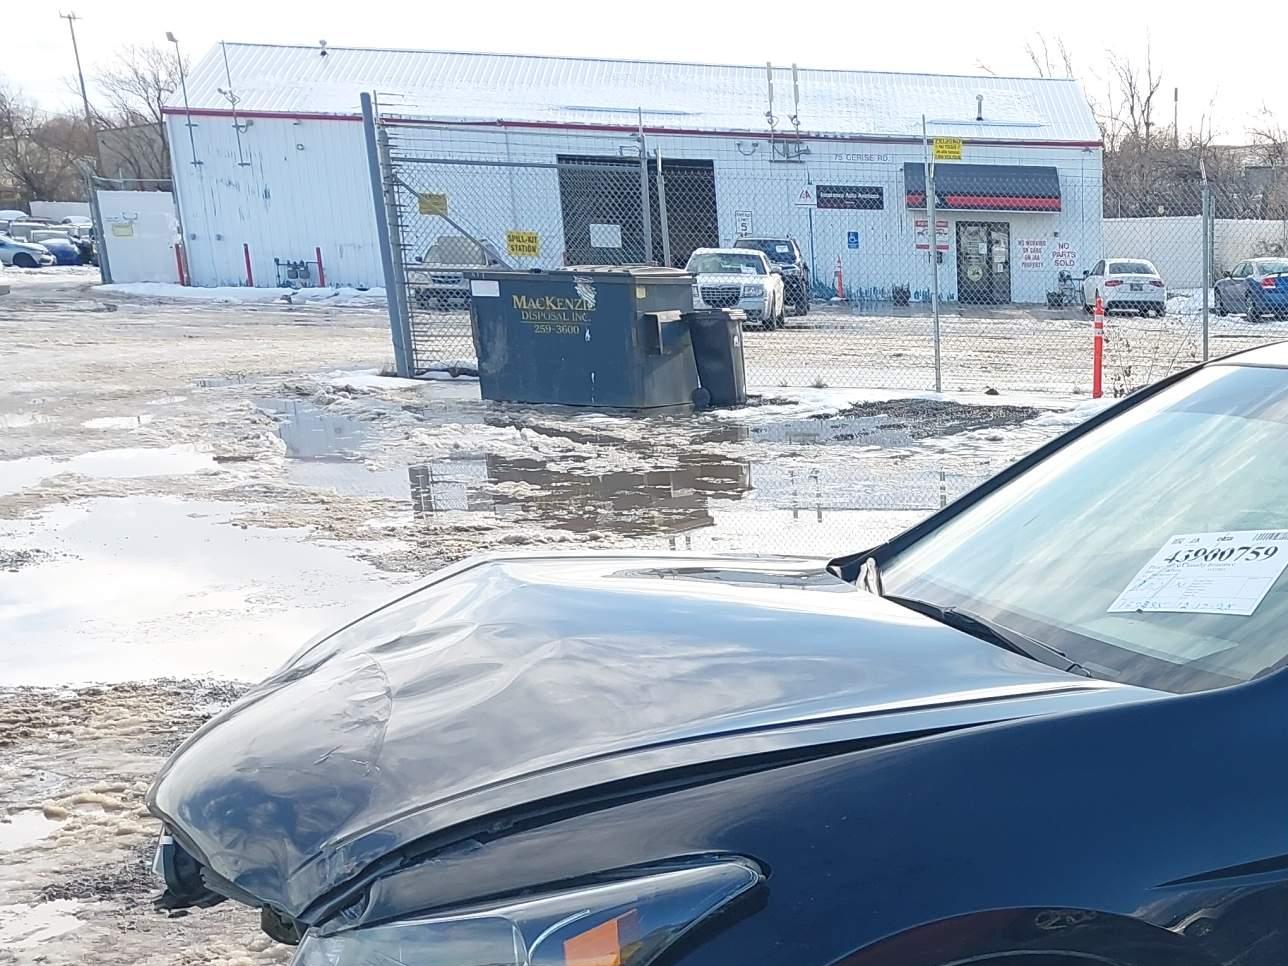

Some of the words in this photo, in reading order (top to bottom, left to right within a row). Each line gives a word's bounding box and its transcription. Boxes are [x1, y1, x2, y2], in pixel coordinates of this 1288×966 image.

[741, 222, 748, 231] 5
[510, 244, 537, 253] STATION
[1058, 242, 1070, 250] NO
[1054, 259, 1075, 267] SOLD
[521, 310, 570, 321] DISPOSAL
[534, 324, 580, 335] 259-3600
